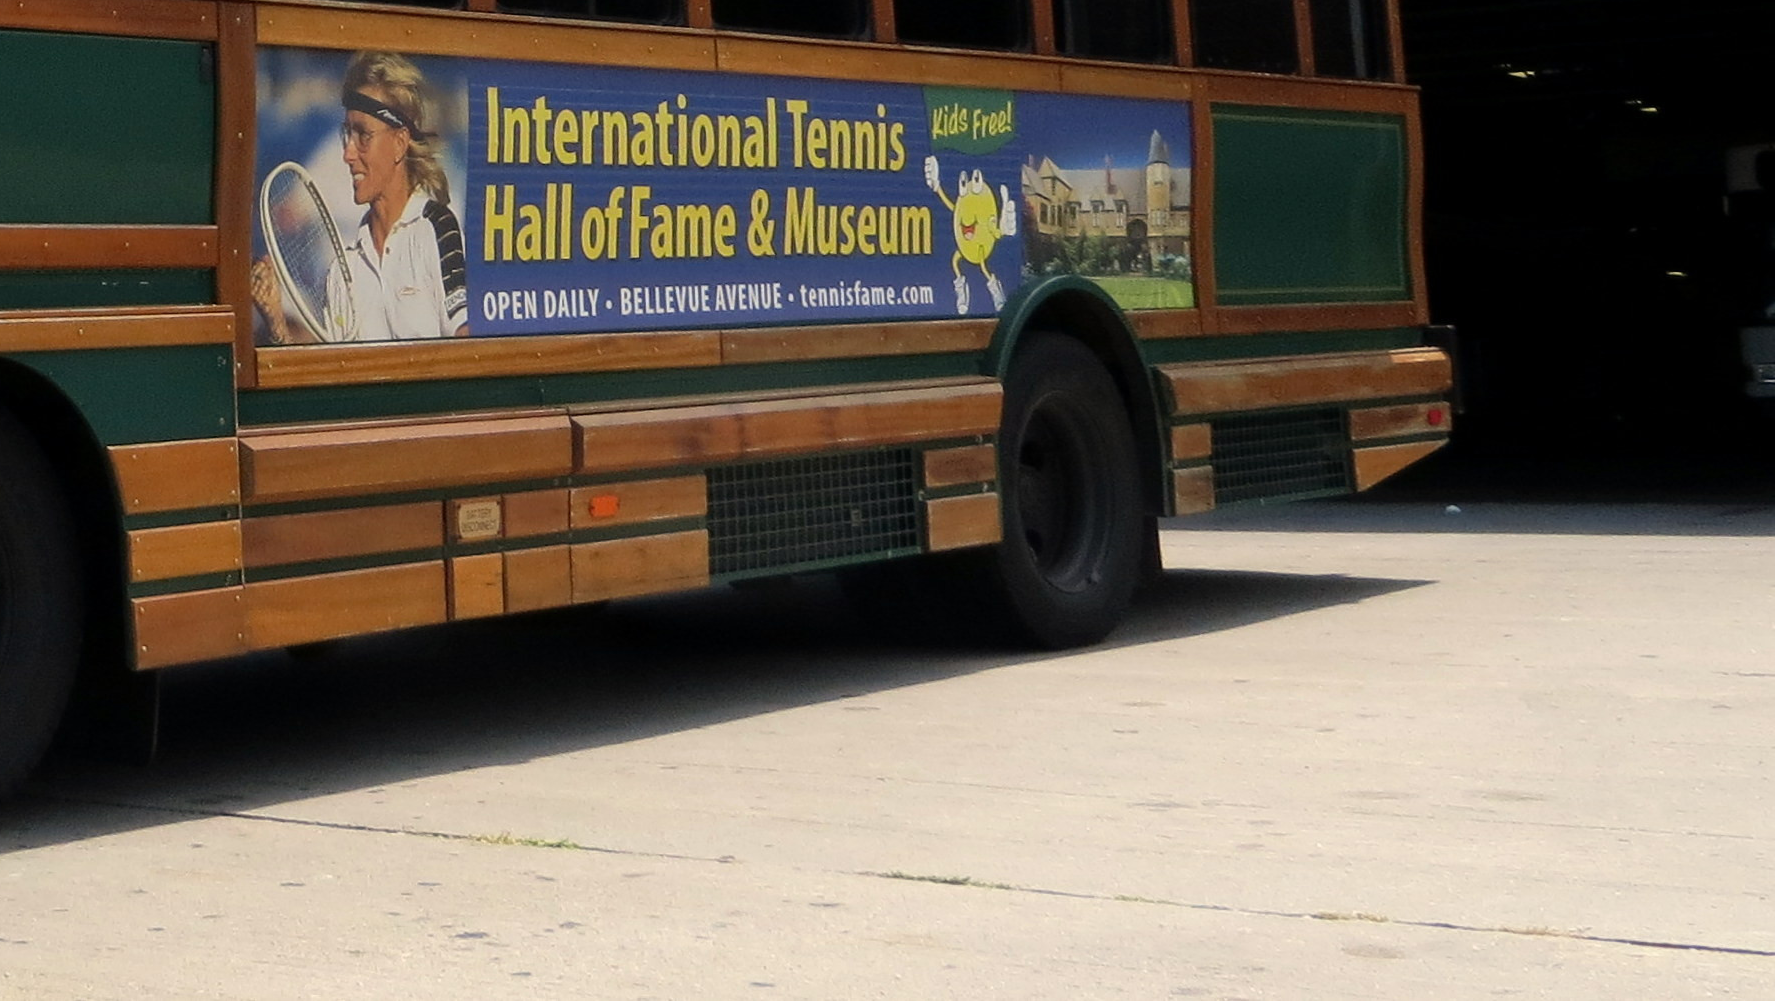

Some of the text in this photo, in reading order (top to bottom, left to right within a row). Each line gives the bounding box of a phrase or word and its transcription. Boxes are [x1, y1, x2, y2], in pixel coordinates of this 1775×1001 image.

[487, 86, 906, 172] International Tennis
[931, 100, 1013, 141] Kids Free!
[483, 183, 933, 262] Hall of Fame & Museum
[483, 290, 538, 321] OPEN
[543, 288, 600, 319] DAILY
[620, 285, 711, 316] BELLEVUE
[715, 282, 783, 312] AVENUE
[799, 280, 934, 308] tennisfame.com
